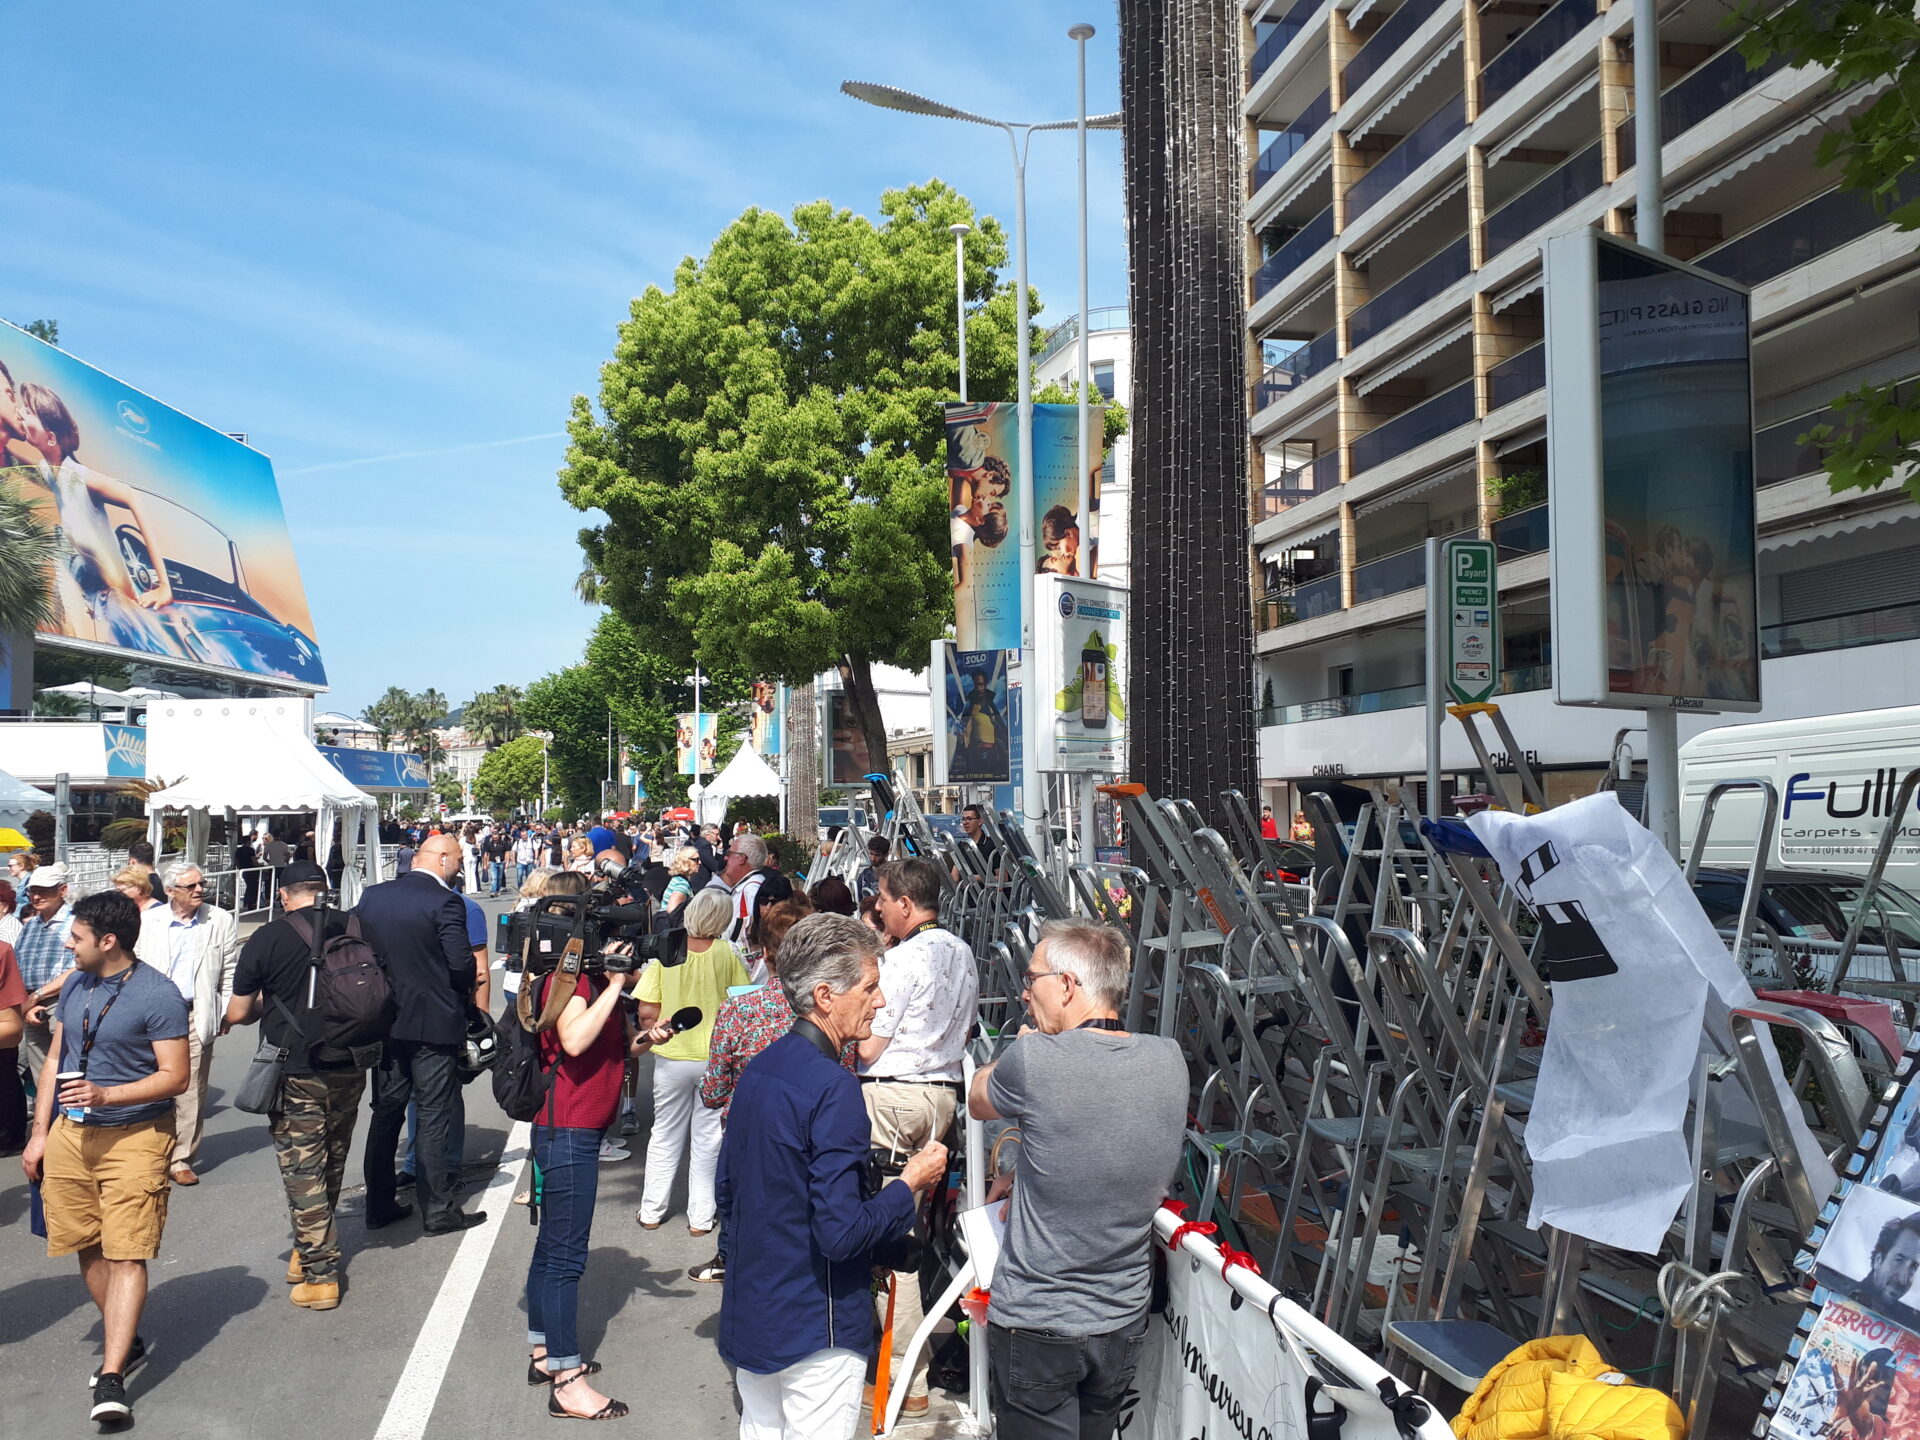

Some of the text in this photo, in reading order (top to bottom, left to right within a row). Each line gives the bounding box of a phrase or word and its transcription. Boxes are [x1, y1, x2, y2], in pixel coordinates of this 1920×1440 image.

[1457, 553, 1487, 578] Payant
[1461, 642, 1485, 650] CANNES
[965, 653, 987, 665] SOLO
[1669, 696, 1704, 708] JCDecaux
[1490, 750, 1543, 767] CHAEL
[1312, 763, 1346, 777] CHANEL
[1781, 827, 1862, 839] Carpets
[1779, 1405, 1801, 1424] FILM
[1800, 1415, 1814, 1429] DE
